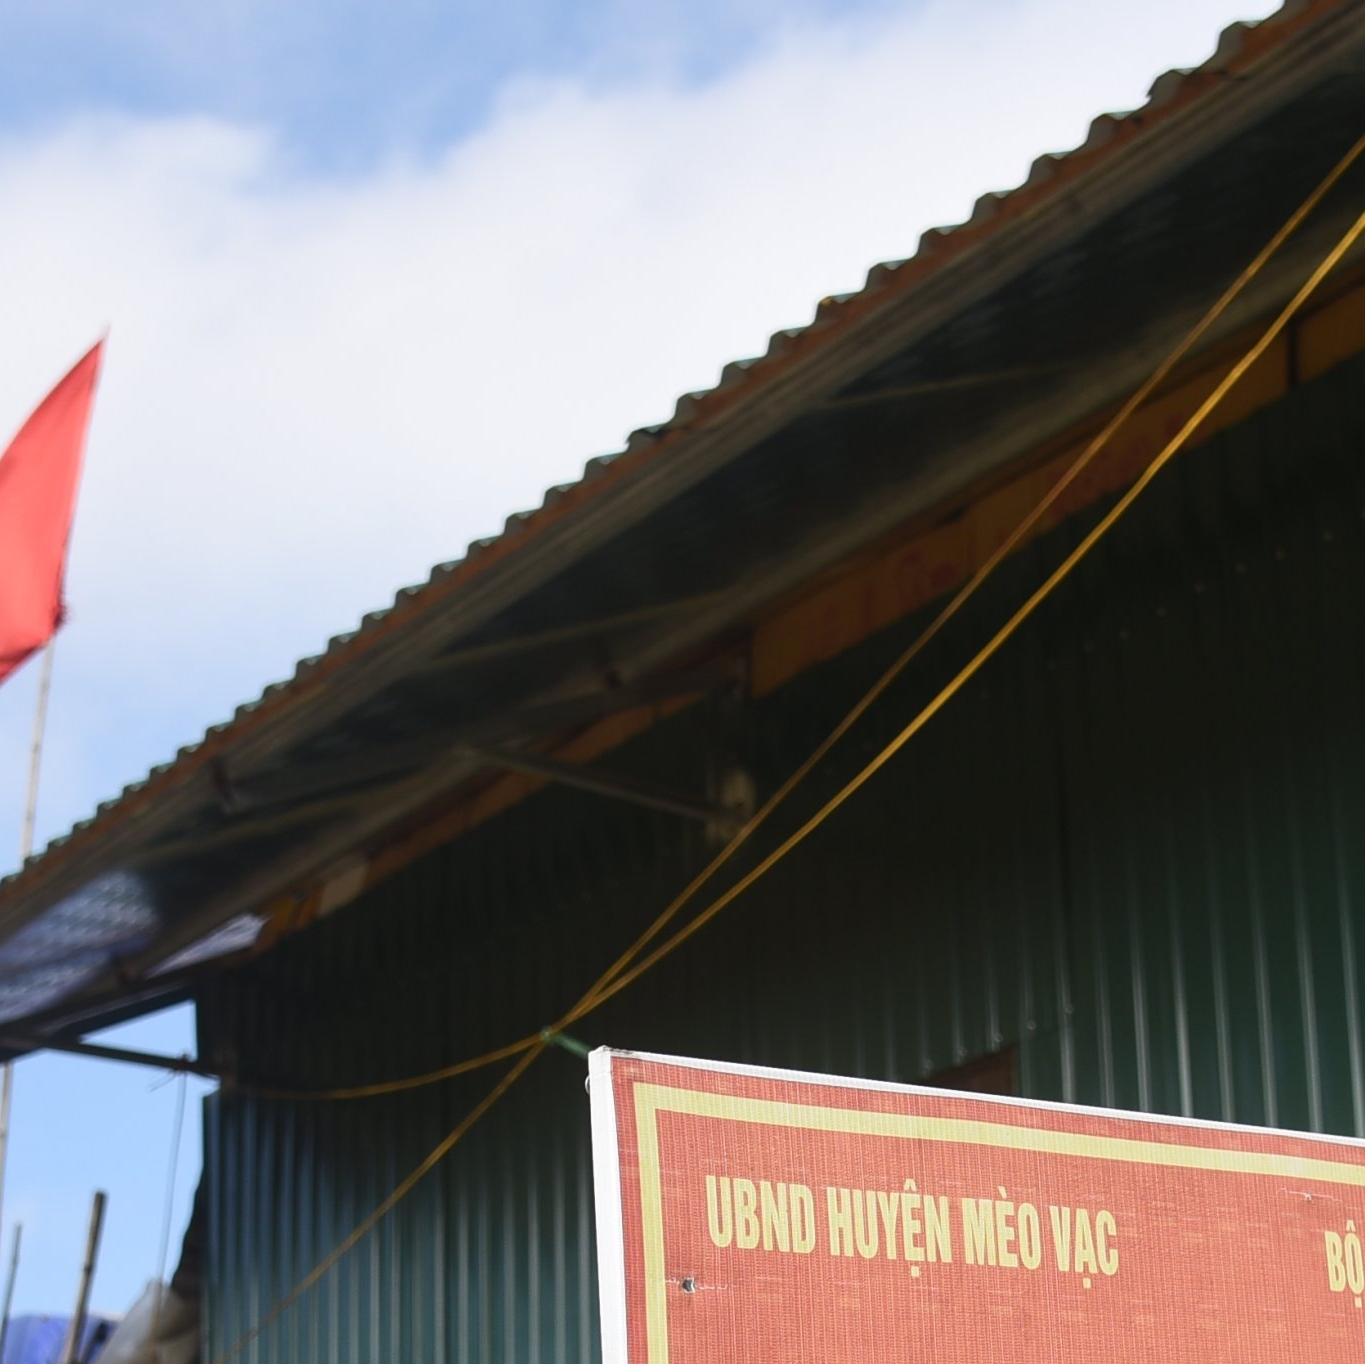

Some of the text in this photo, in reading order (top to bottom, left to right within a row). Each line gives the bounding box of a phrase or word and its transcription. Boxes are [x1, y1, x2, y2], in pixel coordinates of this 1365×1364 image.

[706, 1176, 1118, 1287] UBND HUYỆN MÈO VẠC
[1325, 1221, 1364, 1306] BỘ
